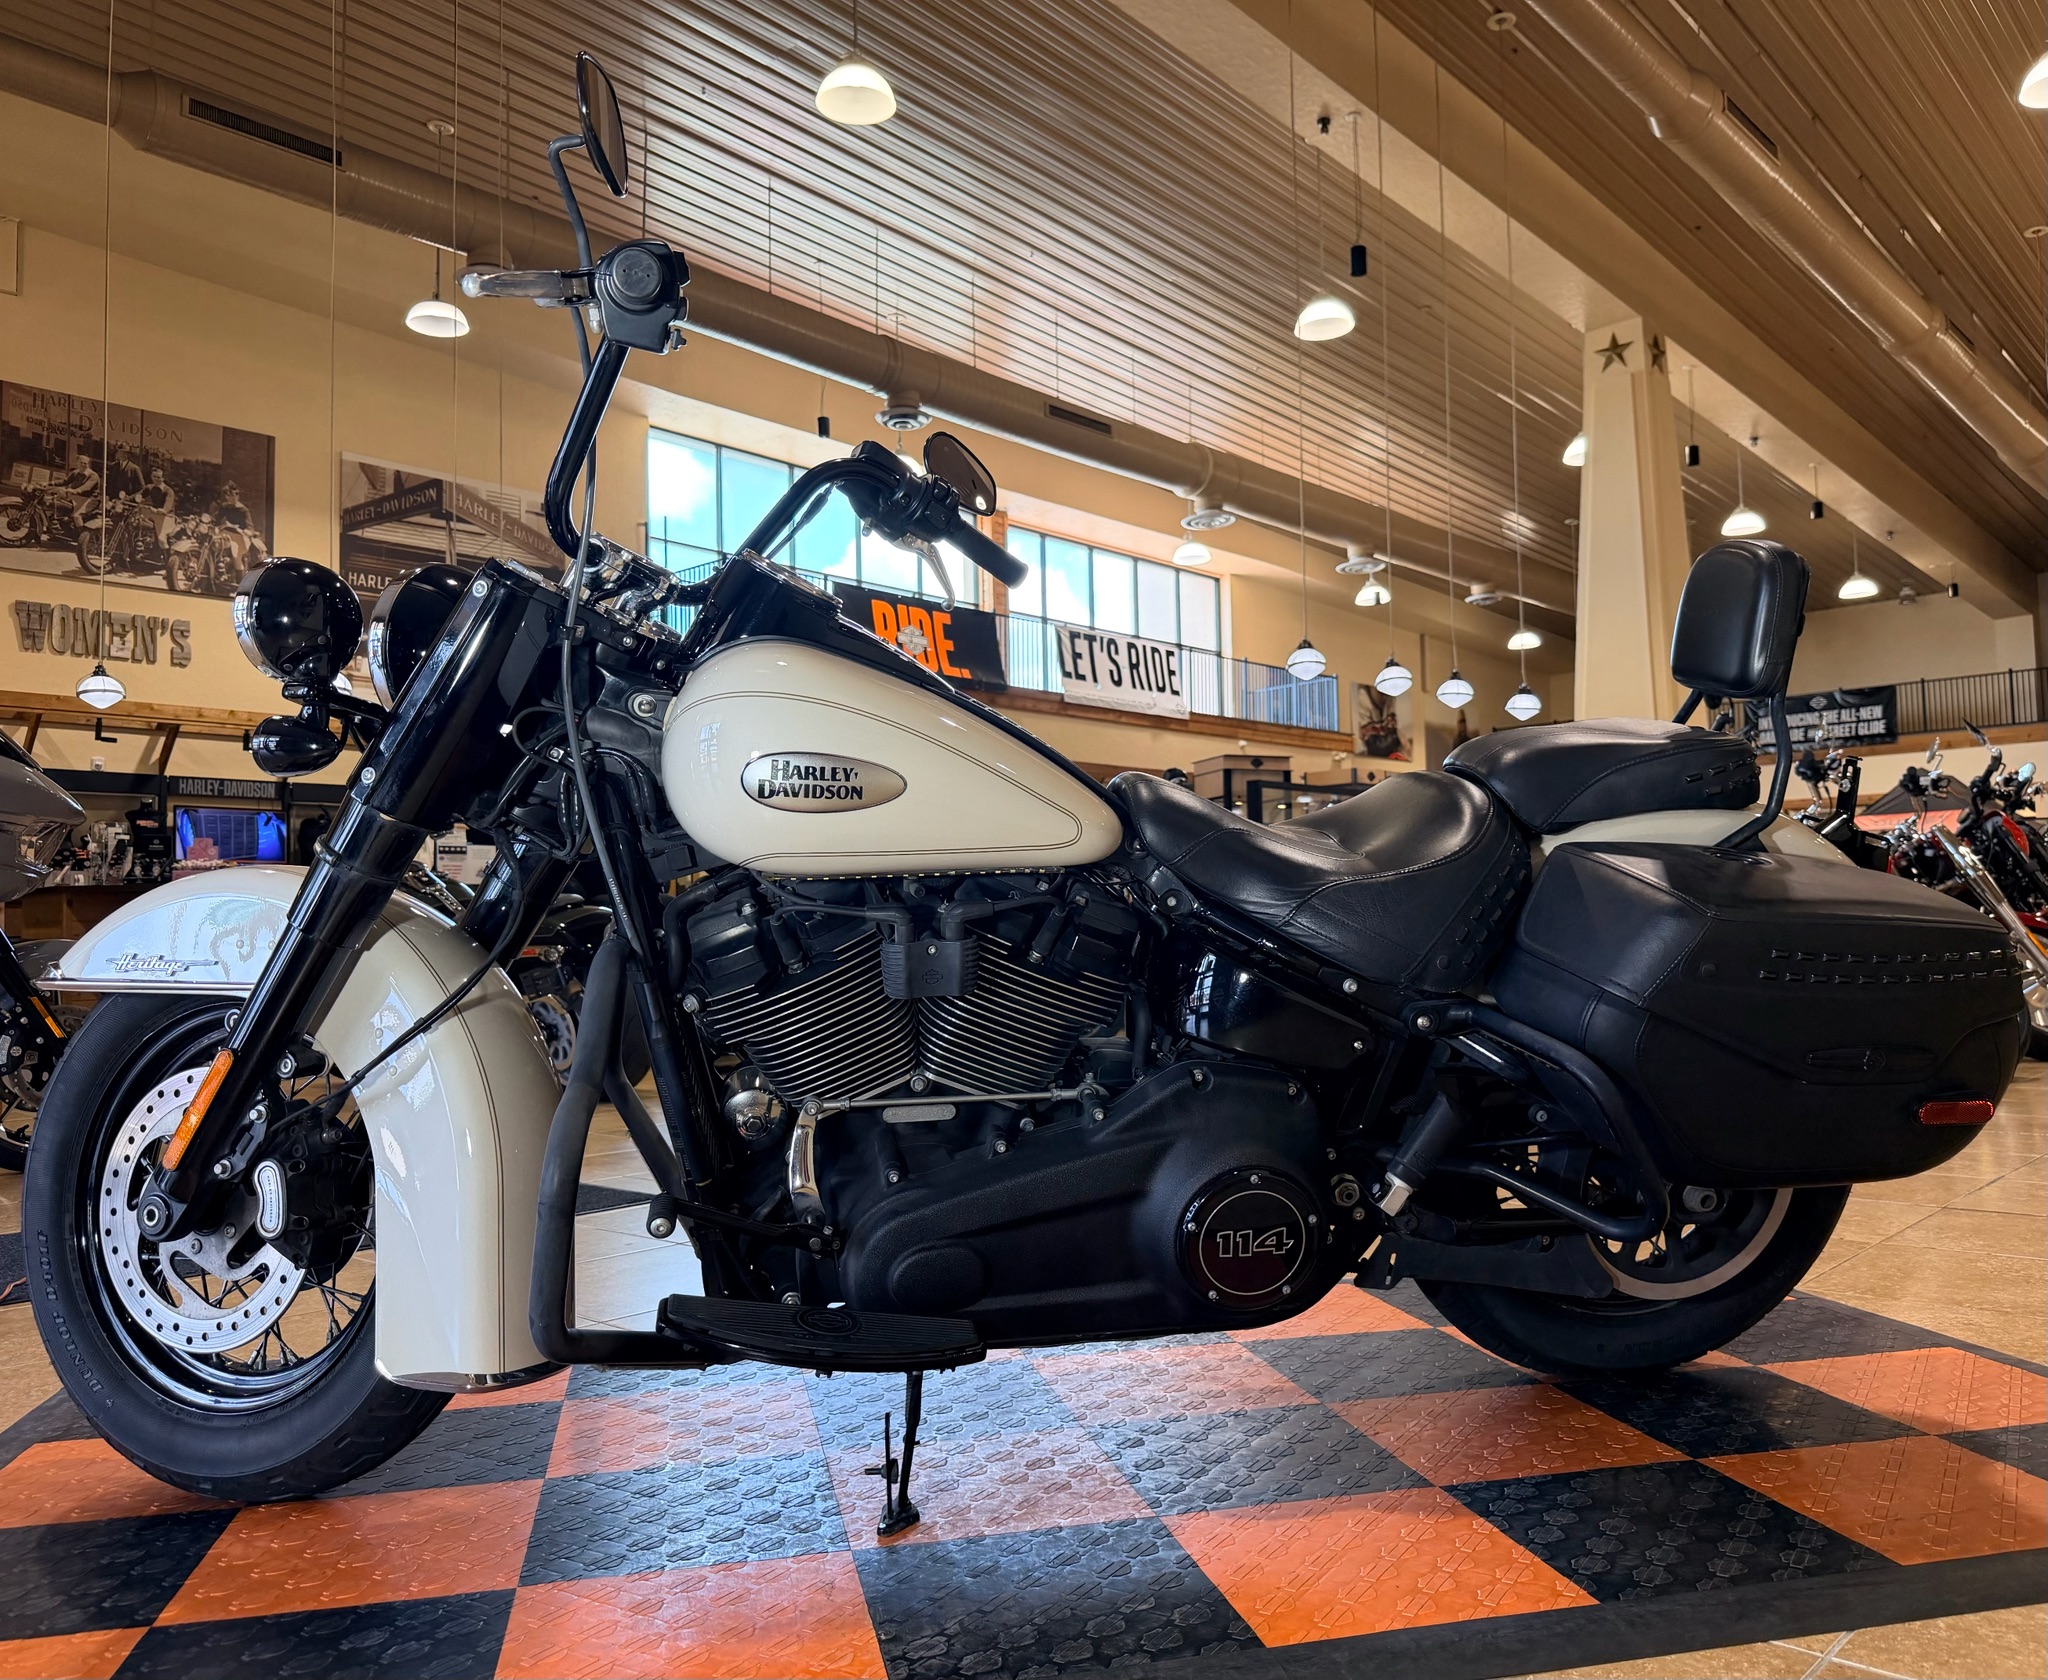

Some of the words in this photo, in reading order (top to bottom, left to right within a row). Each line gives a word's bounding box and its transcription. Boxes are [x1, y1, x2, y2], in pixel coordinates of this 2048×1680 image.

[32, 391, 100, 414] HARLEY
[79, 414, 184, 443] DAVIDSON
[343, 486, 438, 525] HARLEY-DAVIDSON
[348, 571, 393, 590] HARLE
[14, 599, 192, 668] WOMEN'S
[1059, 630, 1123, 688] LET'S
[1127, 641, 1182, 697] RIDE
[1857, 719, 1887, 736] GLIDE
[178, 778, 276, 799] HARLEY-DAVIDSON
[757, 779, 863, 800] DAVIDSON
[114, 952, 187, 977] Heritage
[1216, 1227, 1295, 1258] 114
[52, 1311, 104, 1394] DUNLOP
